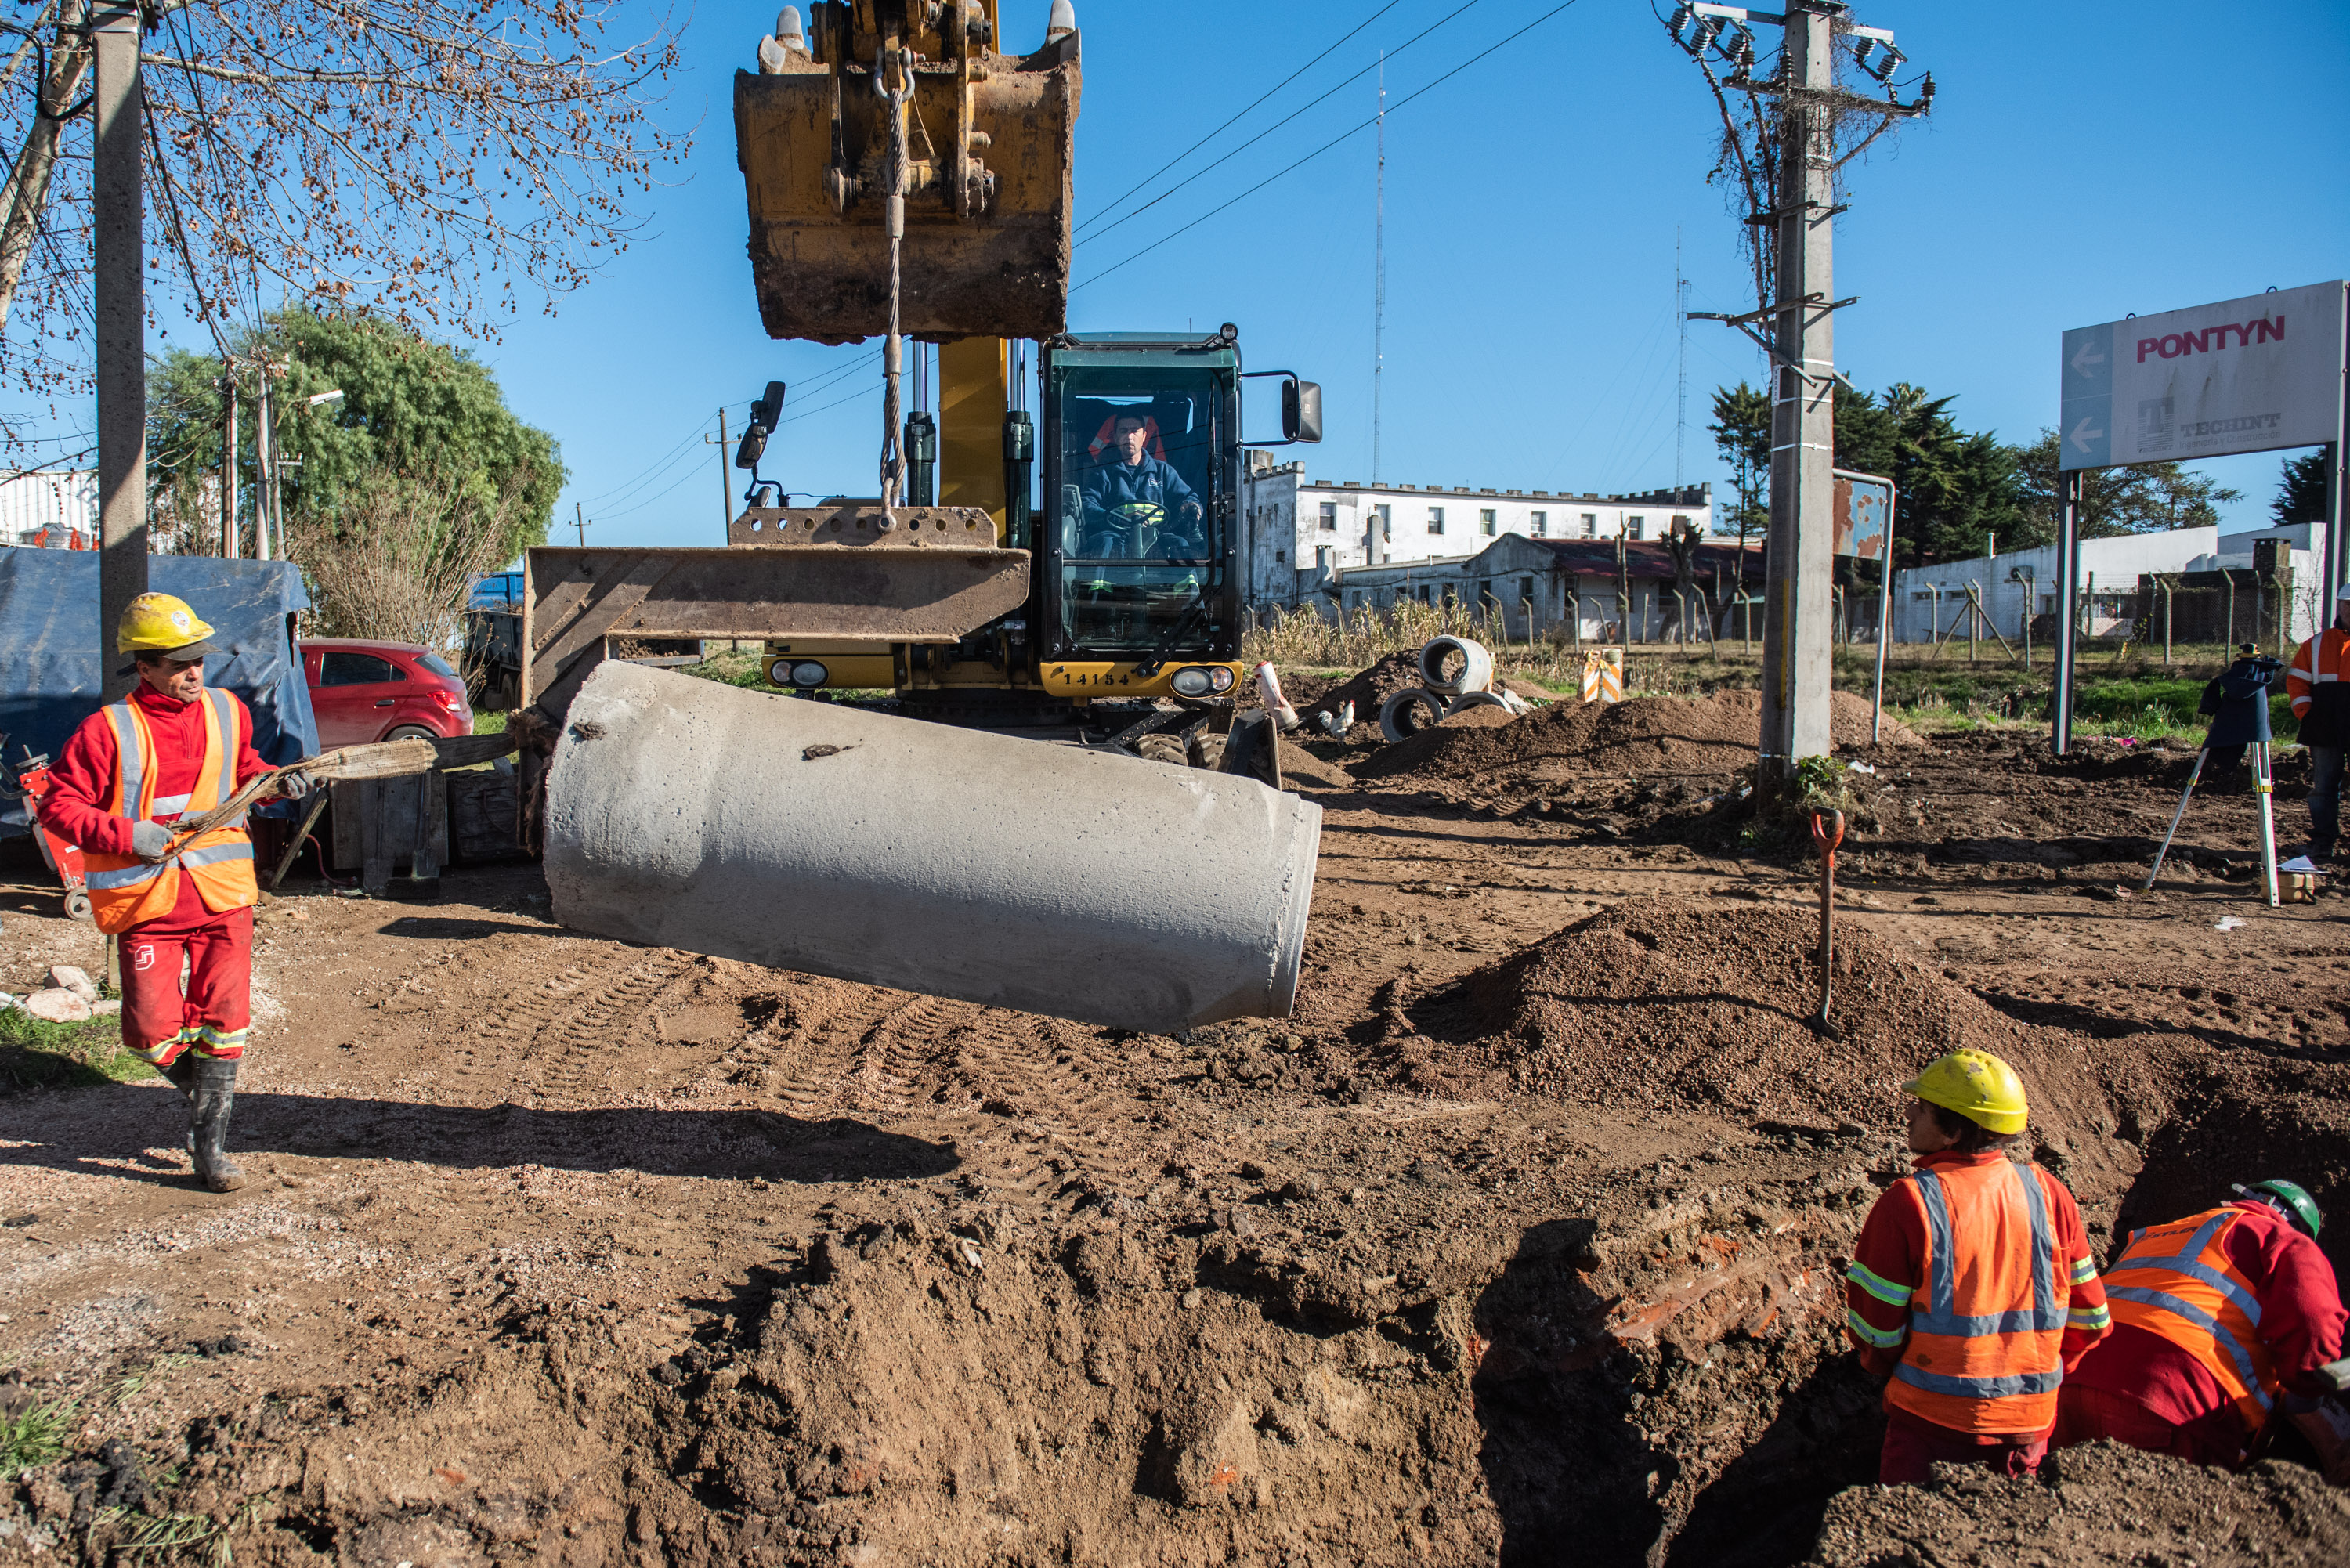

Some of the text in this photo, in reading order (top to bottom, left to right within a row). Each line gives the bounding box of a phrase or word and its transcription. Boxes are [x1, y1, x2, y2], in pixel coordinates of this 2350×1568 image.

[2137, 315, 2285, 363] PONTYN
[2180, 413, 2281, 438] TECHINT
[1064, 674, 1129, 685] 14154
